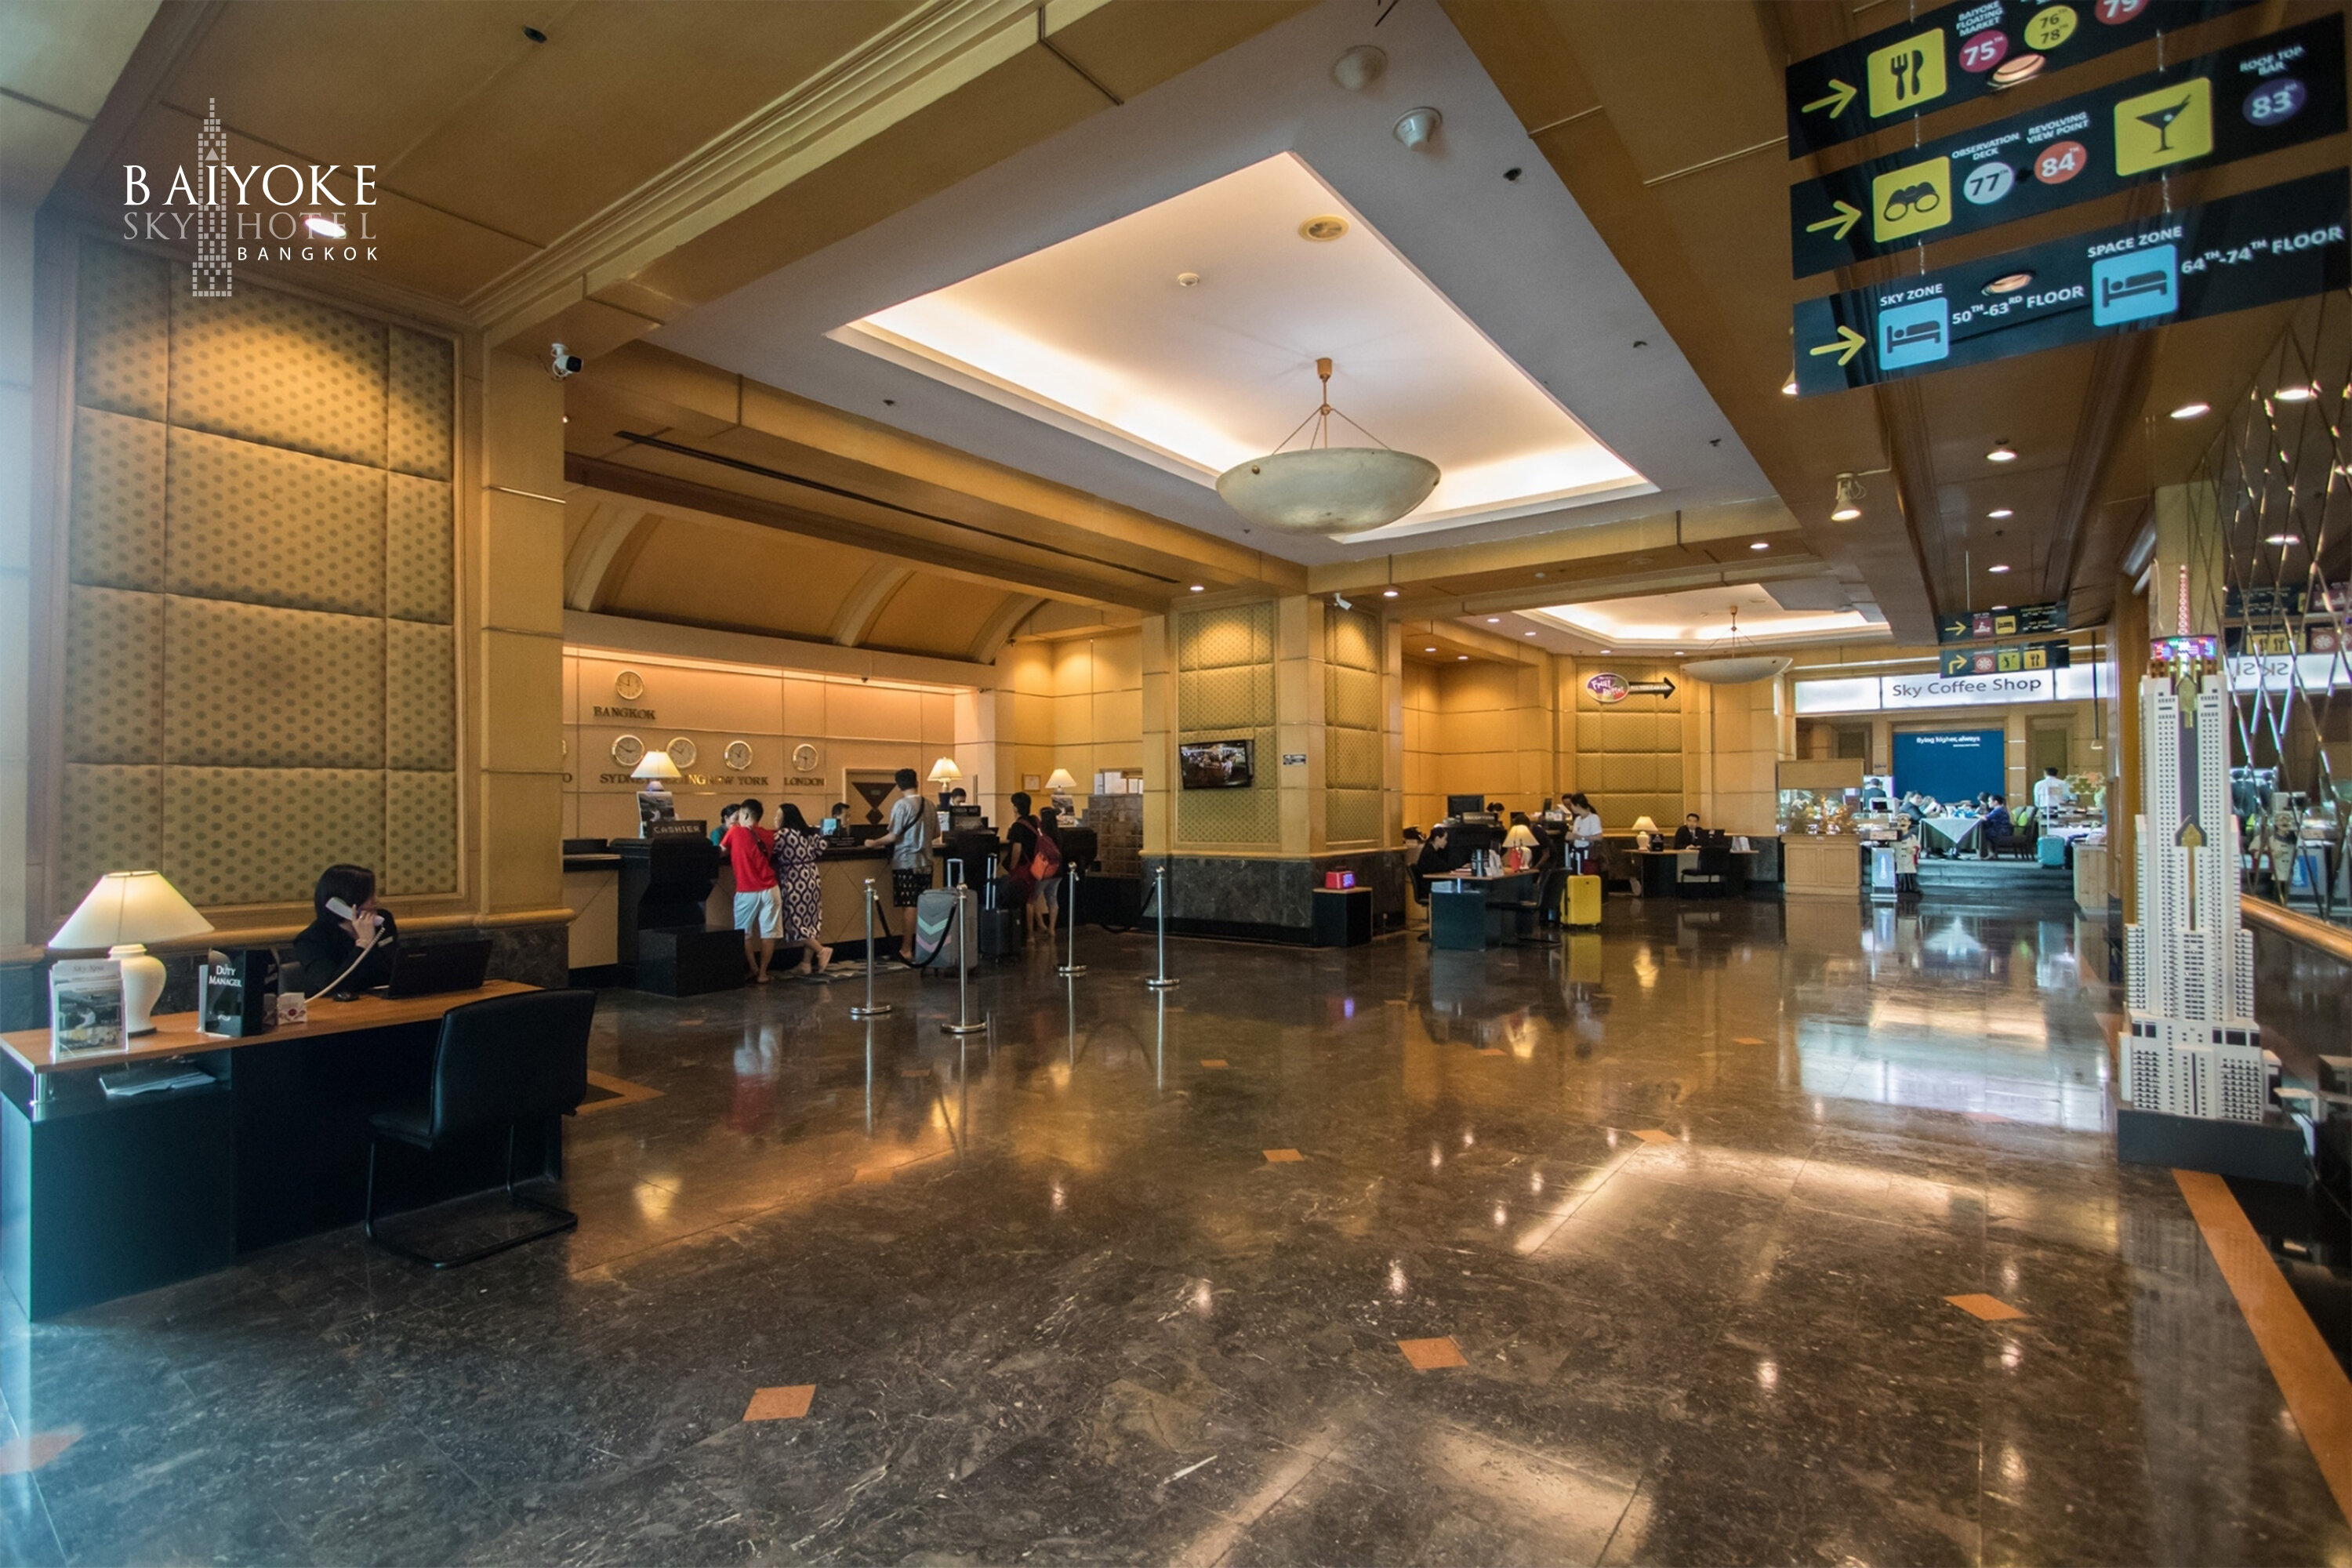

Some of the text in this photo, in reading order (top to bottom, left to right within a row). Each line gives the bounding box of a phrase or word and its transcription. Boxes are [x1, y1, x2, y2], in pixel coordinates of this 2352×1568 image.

[1956, 8, 2004, 30] FLOATING
[1958, 1, 1999, 21] BAIYOKE
[1959, 16, 2001, 37] MARKET
[2240, 45, 2303, 72] ROOF TOP
[2259, 61, 2285, 75] BAR
[2027, 119, 2089, 144] VIEW POINT
[2028, 111, 2088, 136] REVOLVING
[1951, 132, 2020, 159] OBSERVATION
[1973, 147, 1999, 161] DECK
[2087, 226, 2183, 258] SPACE ZONE
[2272, 225, 2344, 254] FLOOR
[1880, 284, 1943, 307] SKY ZONE
[2027, 285, 2085, 308] FLOOR
[1893, 678, 2042, 698] Sky Coffee Shop
[593, 706, 656, 720] BANGKOK
[739, 776, 769, 786] YORK
[784, 777, 826, 786] LONDON
[653, 826, 701, 835] CASHIER
[216, 964, 236, 975] DUTY
[209, 976, 243, 987] MANAGER
